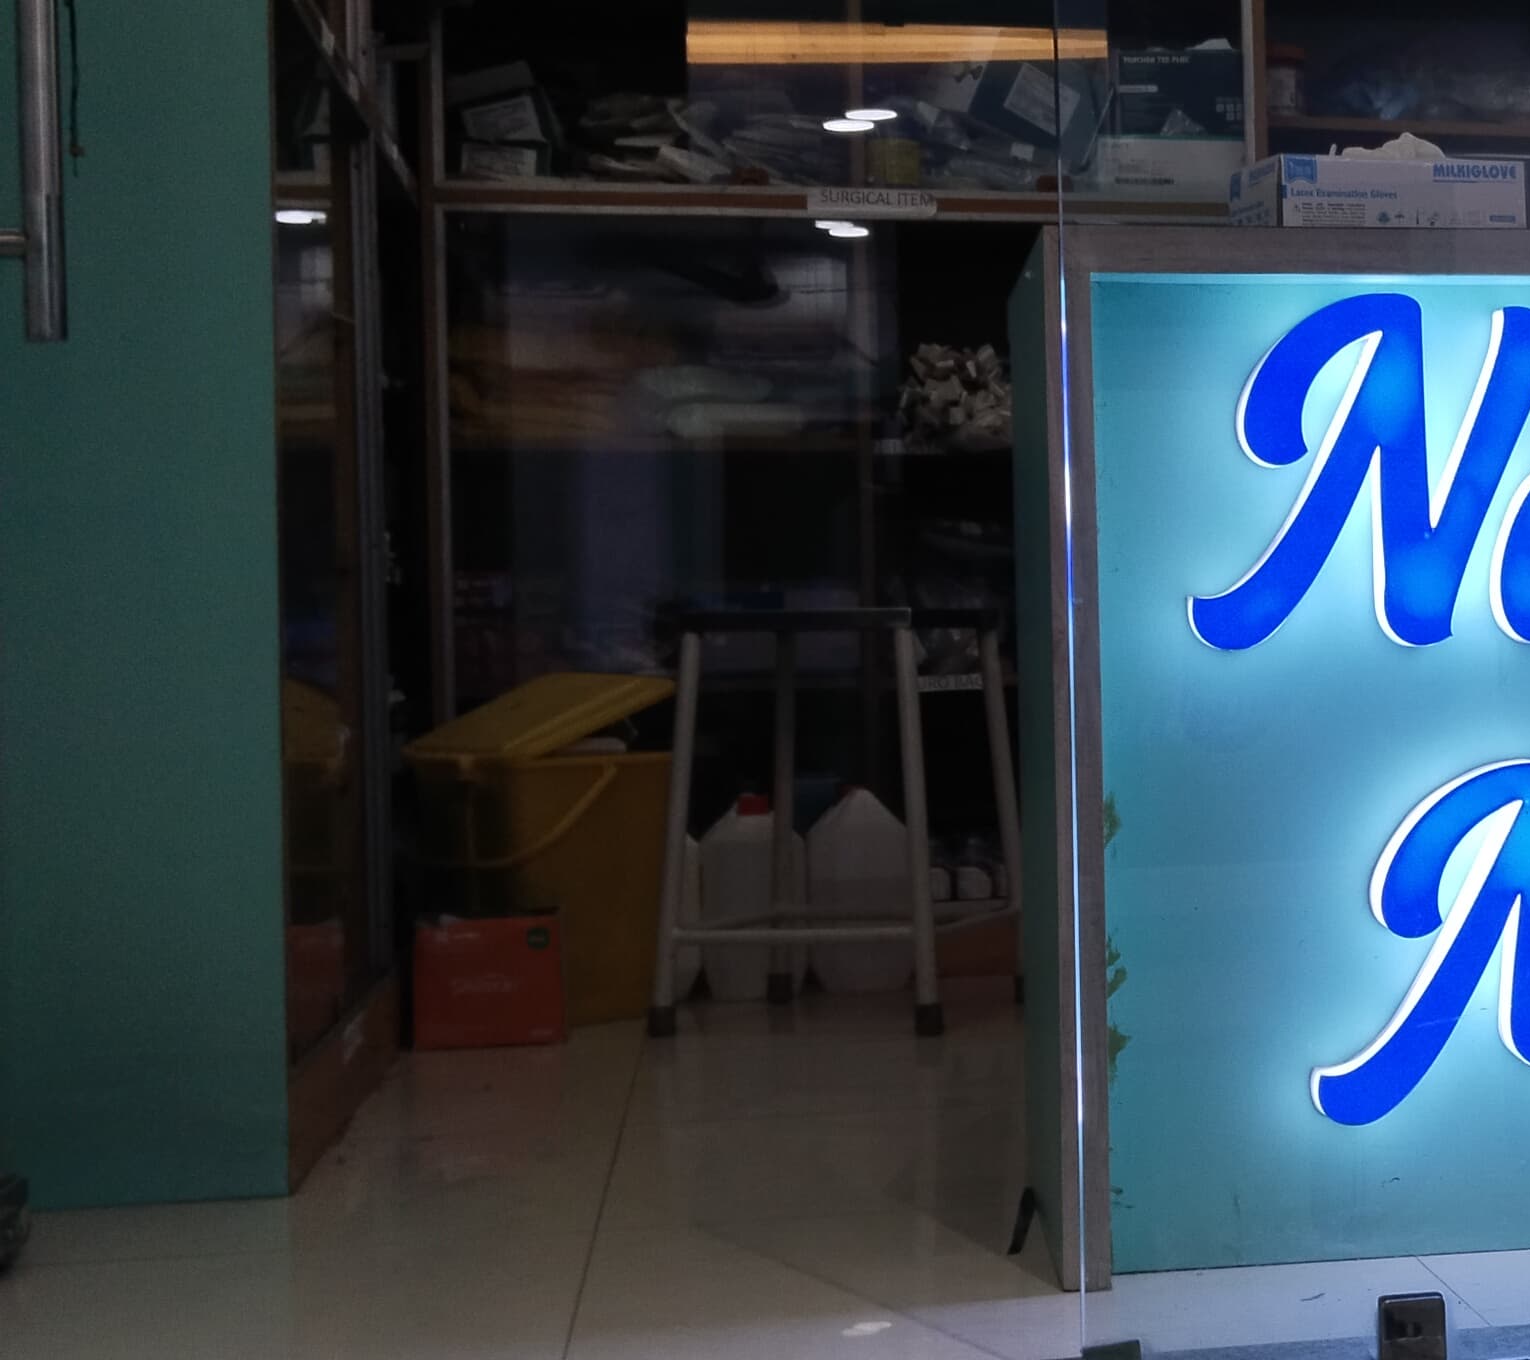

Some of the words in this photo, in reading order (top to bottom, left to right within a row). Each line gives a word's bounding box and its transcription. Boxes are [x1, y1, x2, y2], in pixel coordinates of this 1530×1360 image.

[1432, 163, 1517, 180] MILKIGLOVE
[820, 187, 893, 206] SURGICAL
[1315, 187, 1368, 200] Examination
[1370, 189, 1397, 201] Gloves
